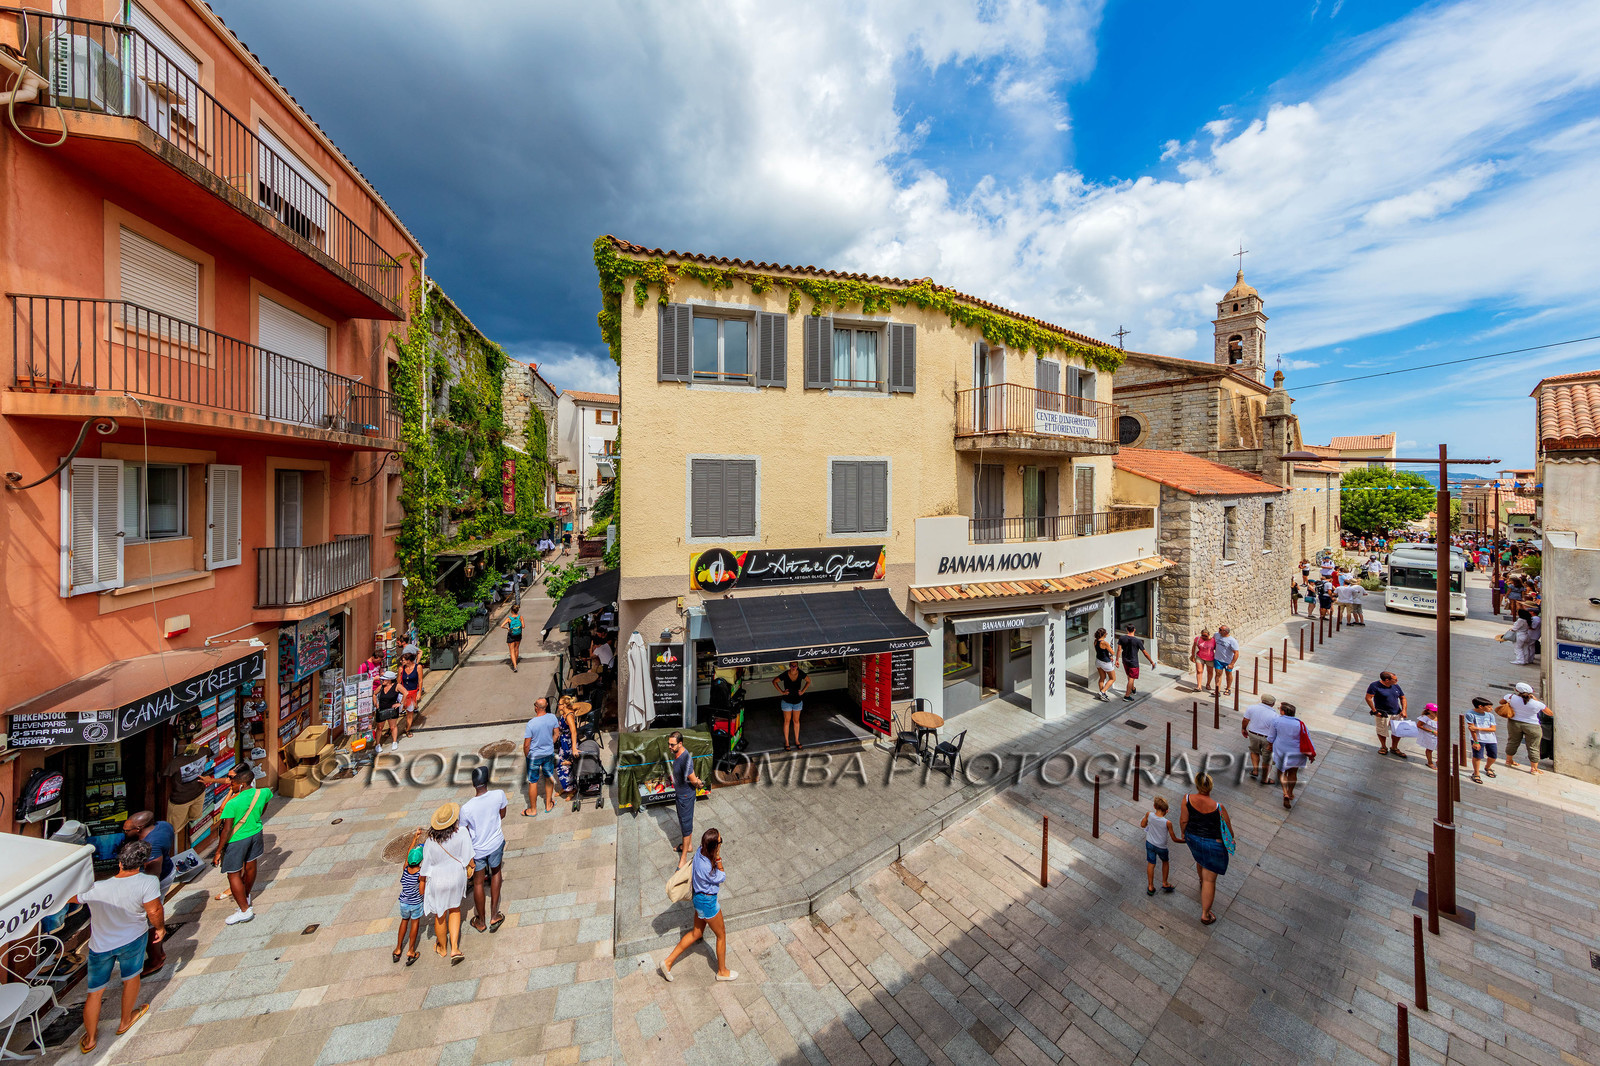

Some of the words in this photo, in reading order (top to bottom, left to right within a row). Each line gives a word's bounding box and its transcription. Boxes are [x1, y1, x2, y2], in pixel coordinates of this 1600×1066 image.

[1036, 411, 1058, 423] CENTRE
[825, 554, 876, 582] Glace
[938, 554, 996, 575] BANANA
[996, 551, 1043, 571] MOON
[1412, 596, 1437, 604] Citadi
[982, 620, 1006, 631] BANANA
[1005, 618, 1025, 629] MOON
[1048, 622, 1056, 665] BANANA
[1048, 667, 1056, 697] MOON
[121, 691, 180, 732] CANAL
[185, 661, 248, 703] STREET
[250, 655, 260, 676] 2
[13, 711, 67, 722] BIRKENSTOCK
[12, 720, 67, 730] ELEVENPARIS
[12, 729, 50, 738] G-STAR
